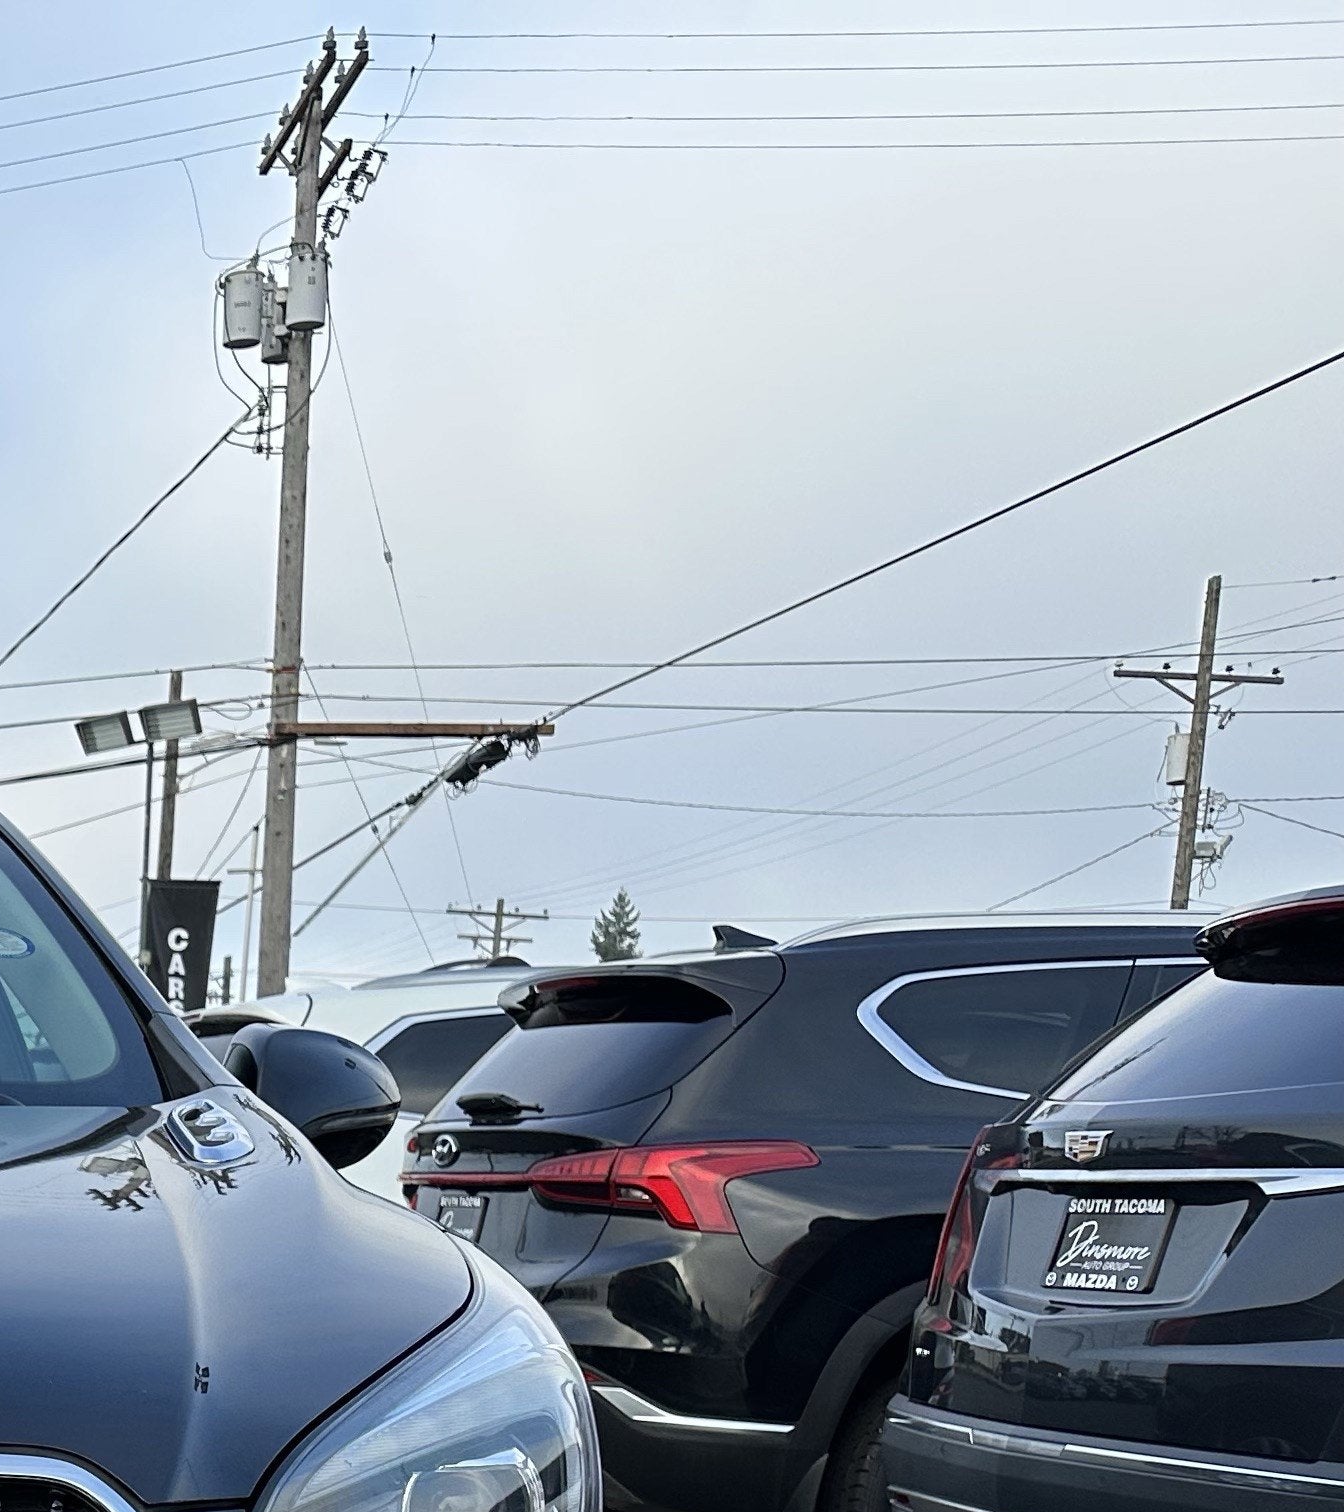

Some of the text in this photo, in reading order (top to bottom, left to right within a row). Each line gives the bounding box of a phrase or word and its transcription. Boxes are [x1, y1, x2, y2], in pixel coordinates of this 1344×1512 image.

[1069, 1198, 1165, 1214] SOUTH TACOMA
[1056, 1220, 1151, 1267] Dinsmore
[1063, 1272, 1117, 1290] MAZDA
